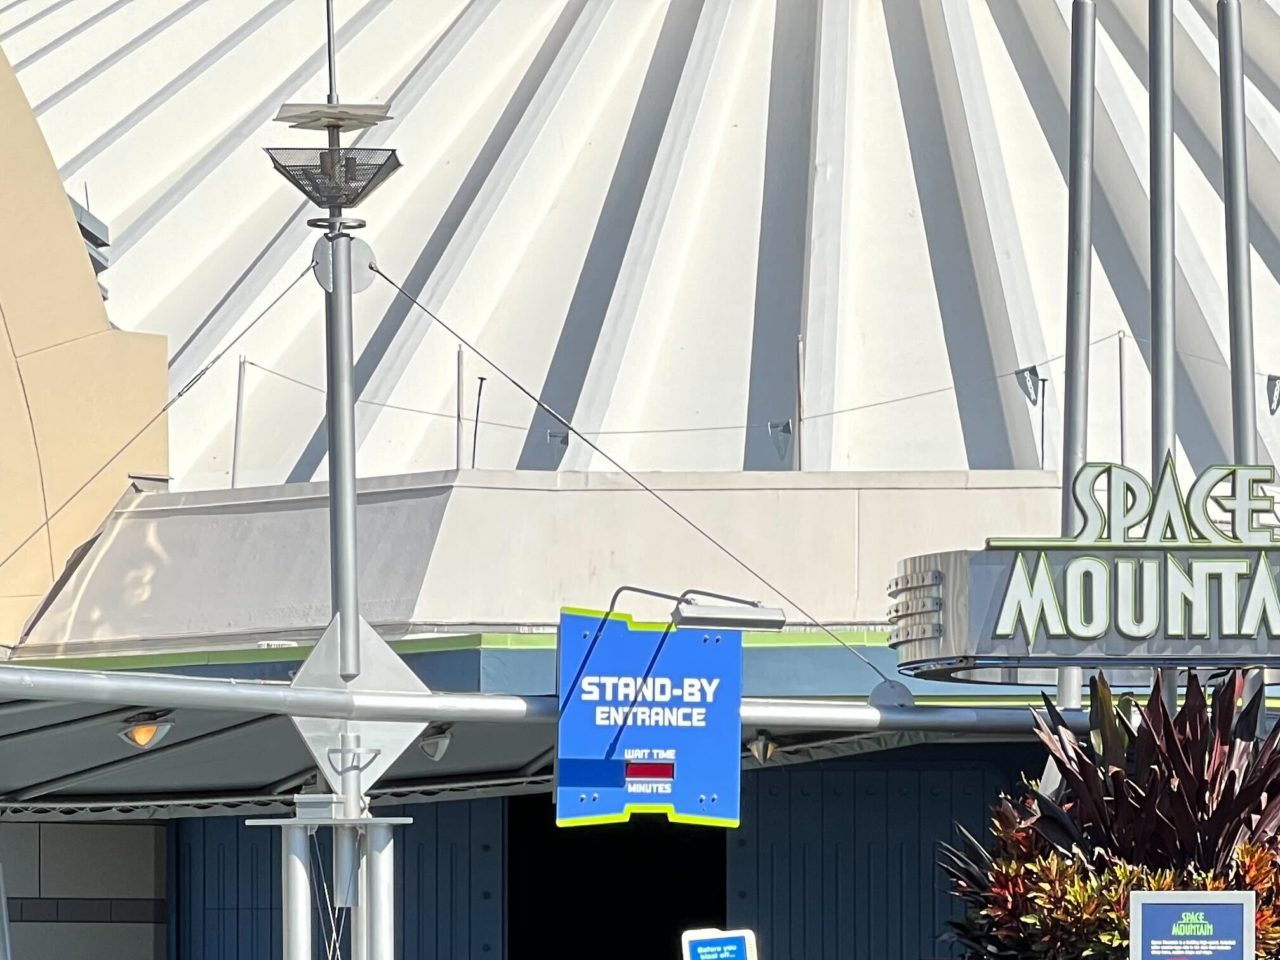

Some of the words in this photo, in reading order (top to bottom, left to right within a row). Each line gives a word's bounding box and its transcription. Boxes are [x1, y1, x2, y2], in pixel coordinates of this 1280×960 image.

[1072, 448, 1276, 544] SPACE
[581, 676, 721, 703] STAND-BY
[595, 706, 707, 727] ENTRANCE
[624, 749, 650, 759] WAIT
[652, 749, 676, 760] TIME
[627, 783, 672, 793] MINUTES
[1181, 911, 1205, 922] SPACE
[1171, 923, 1214, 936] MOUNTAIN
[722, 945, 737, 954] you
